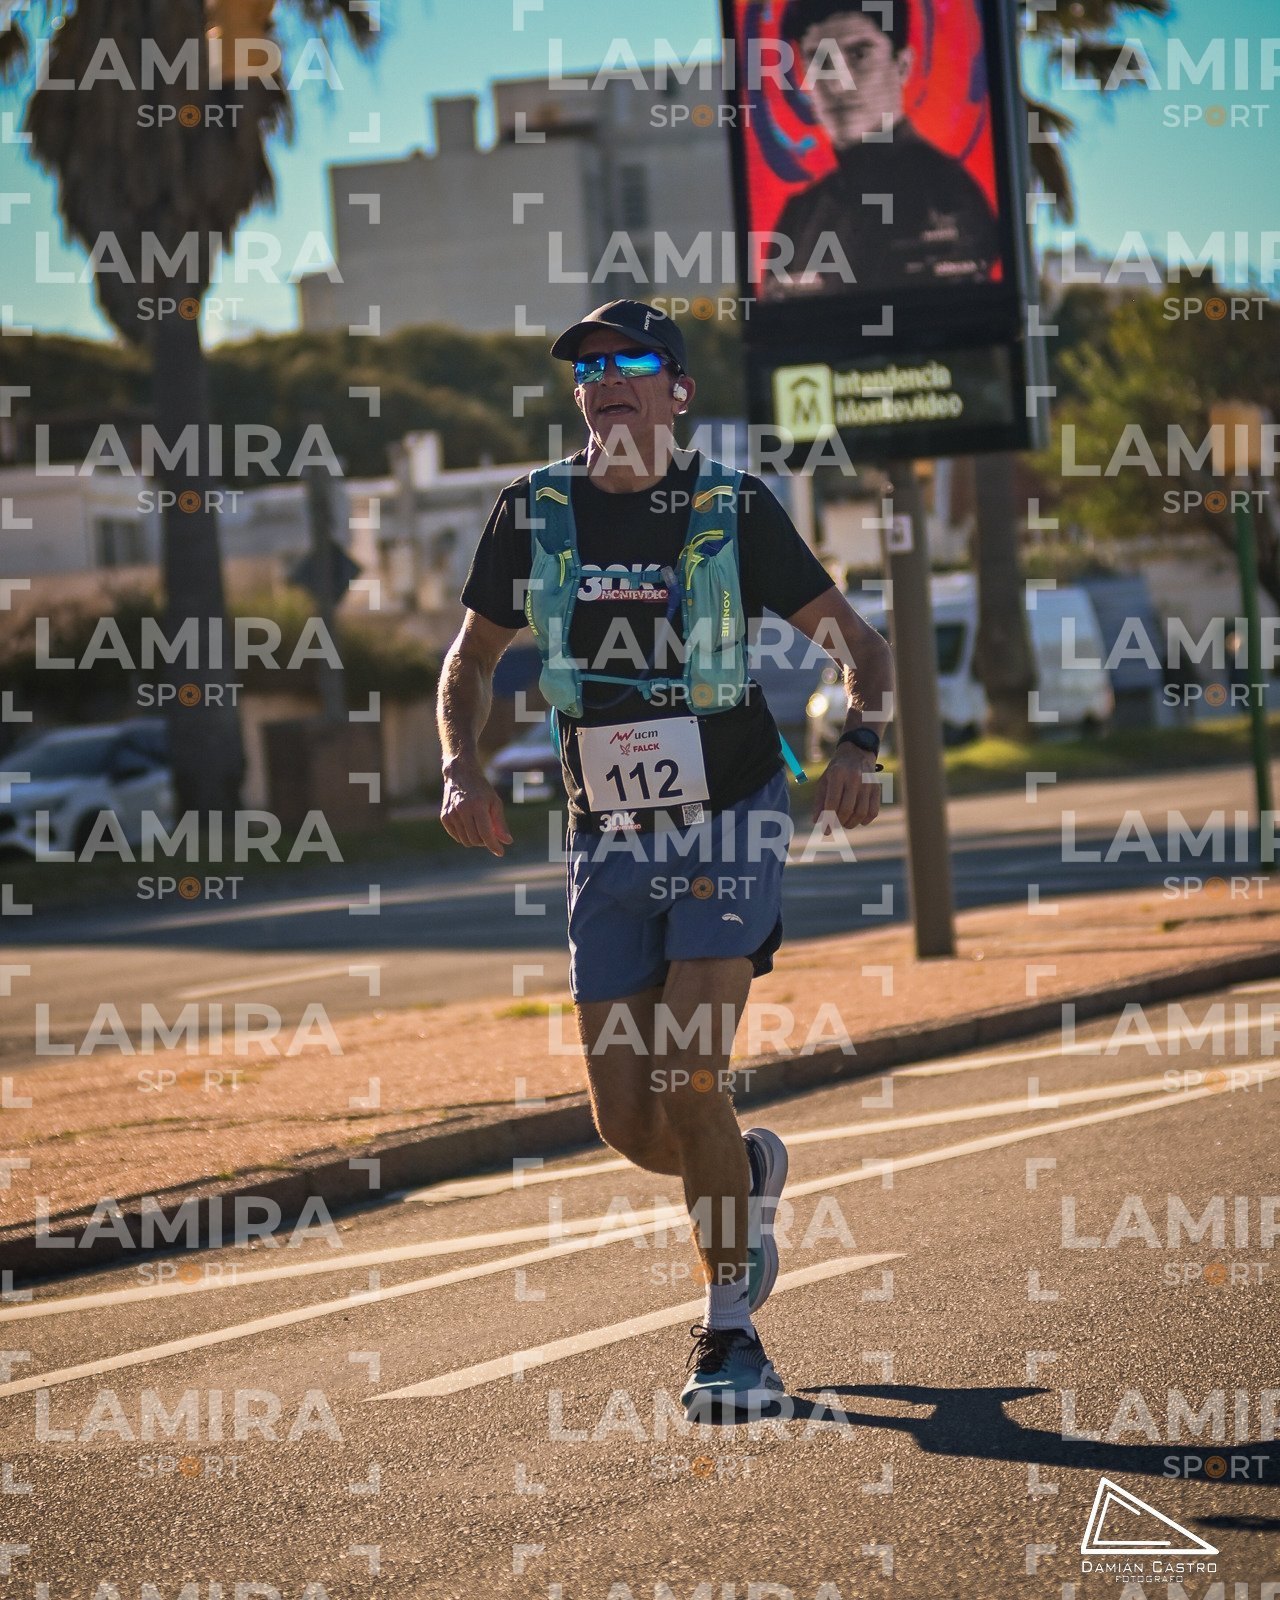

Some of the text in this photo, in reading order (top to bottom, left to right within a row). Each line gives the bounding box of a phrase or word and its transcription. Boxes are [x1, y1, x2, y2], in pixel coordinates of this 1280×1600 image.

[834, 361, 951, 396] Intendencia
[837, 392, 963, 424] Montevideo
[634, 729, 658, 739] ucm
[633, 743, 660, 753] FALCK
[605, 759, 683, 802] 112
[599, 812, 637, 832] 30K
